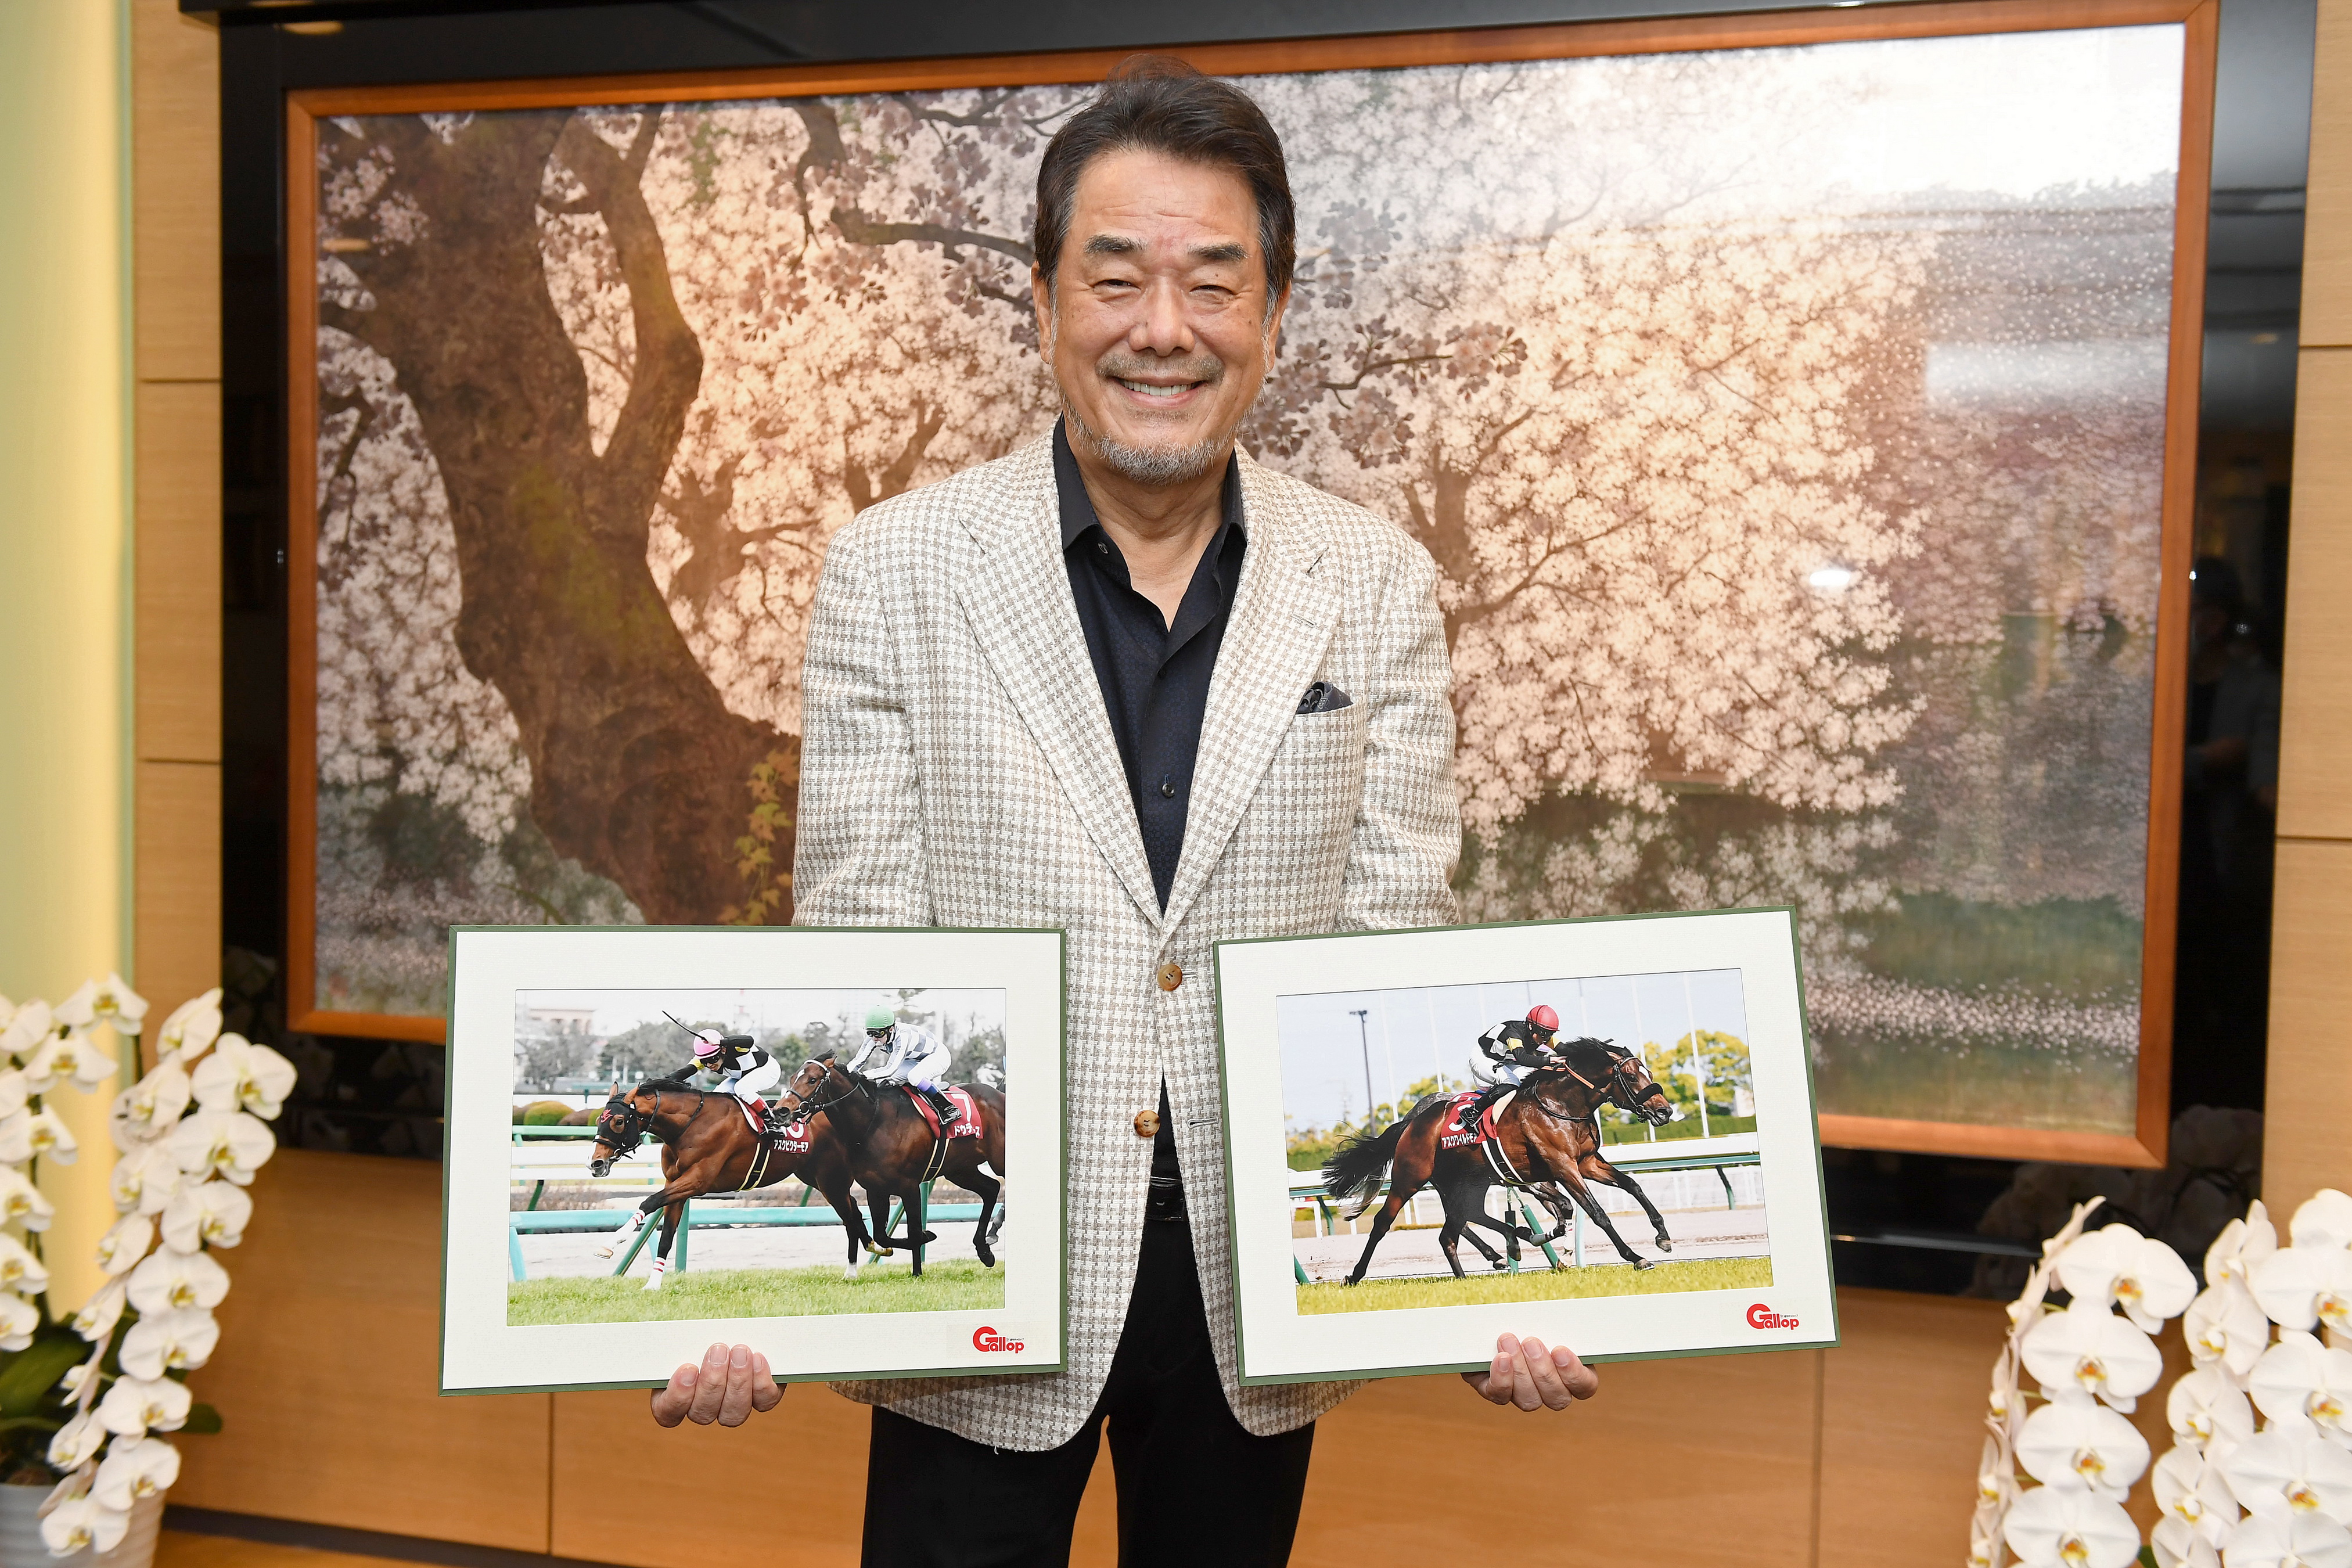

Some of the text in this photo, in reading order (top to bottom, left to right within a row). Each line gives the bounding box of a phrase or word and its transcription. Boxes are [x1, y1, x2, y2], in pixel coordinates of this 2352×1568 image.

[951, 1094, 972, 1122] 7
[774, 1139, 809, 1153] アスクビクターモア
[1746, 1303, 1799, 1330] Gallop
[972, 1326, 1024, 1354] Gallop
